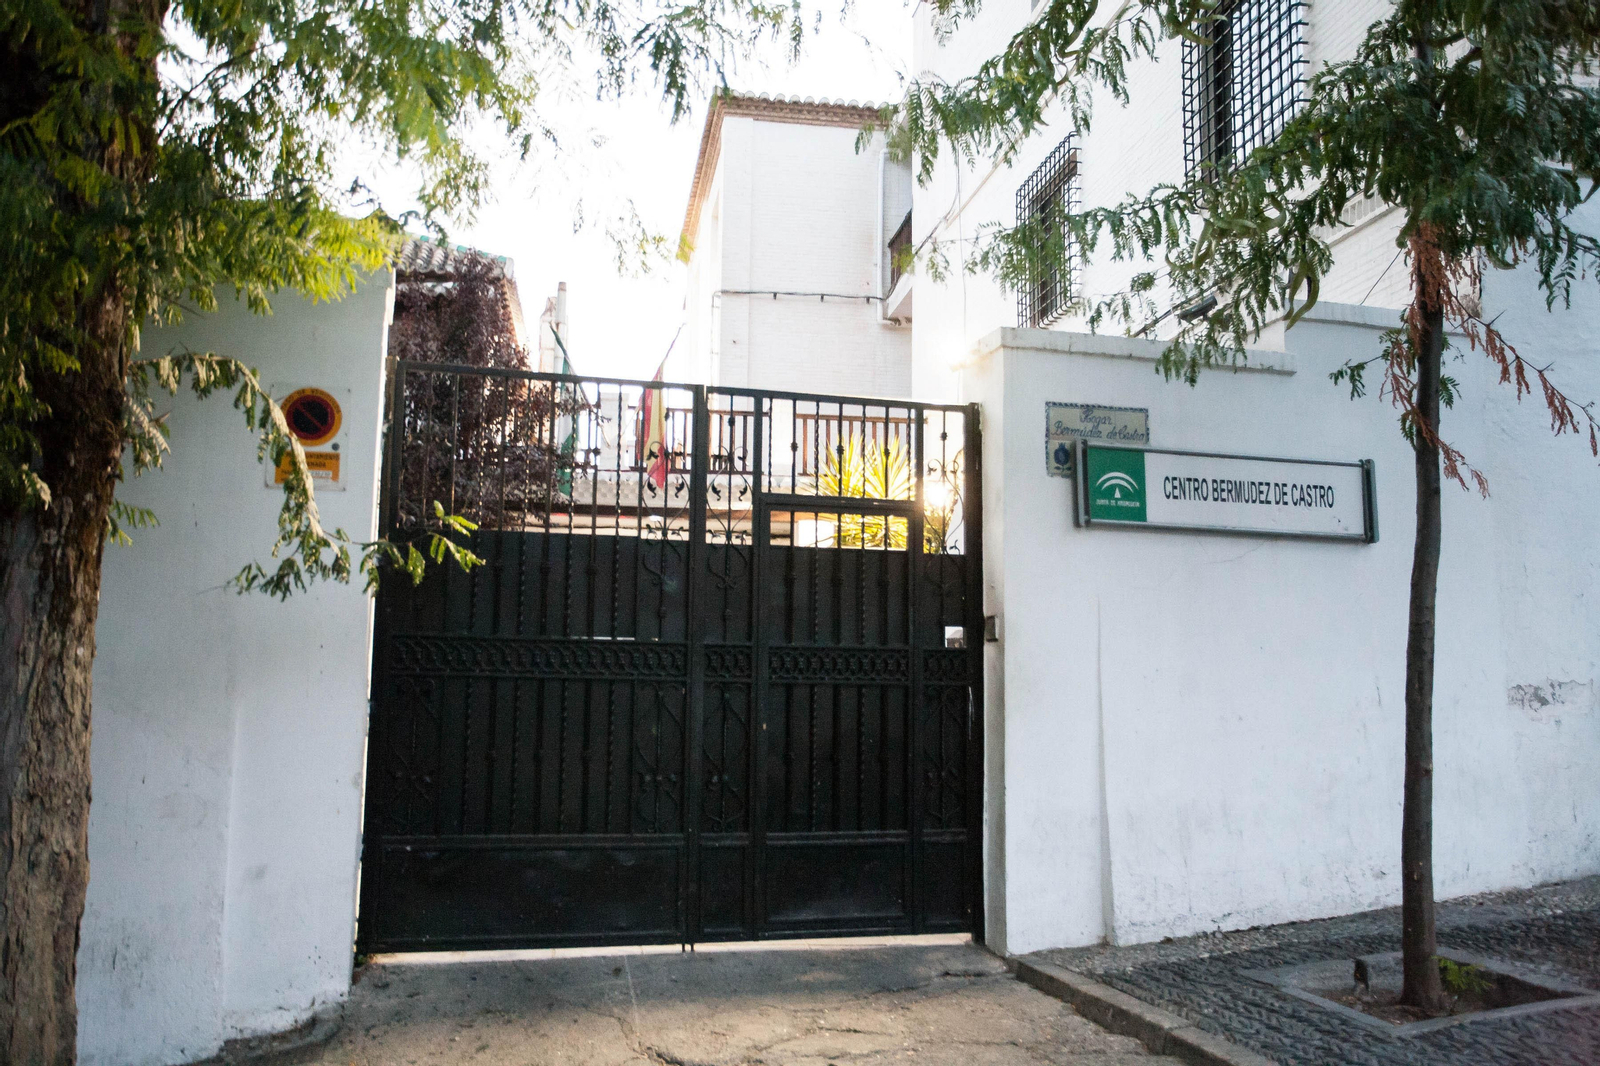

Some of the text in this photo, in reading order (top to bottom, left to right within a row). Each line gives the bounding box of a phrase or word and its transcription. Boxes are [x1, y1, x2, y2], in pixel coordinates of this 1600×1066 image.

[1106, 426, 1117, 439] de
[1117, 425, 1145, 441] Castro
[1163, 476, 1335, 508] CENTRO BERMUDEZ DE CASTRO
